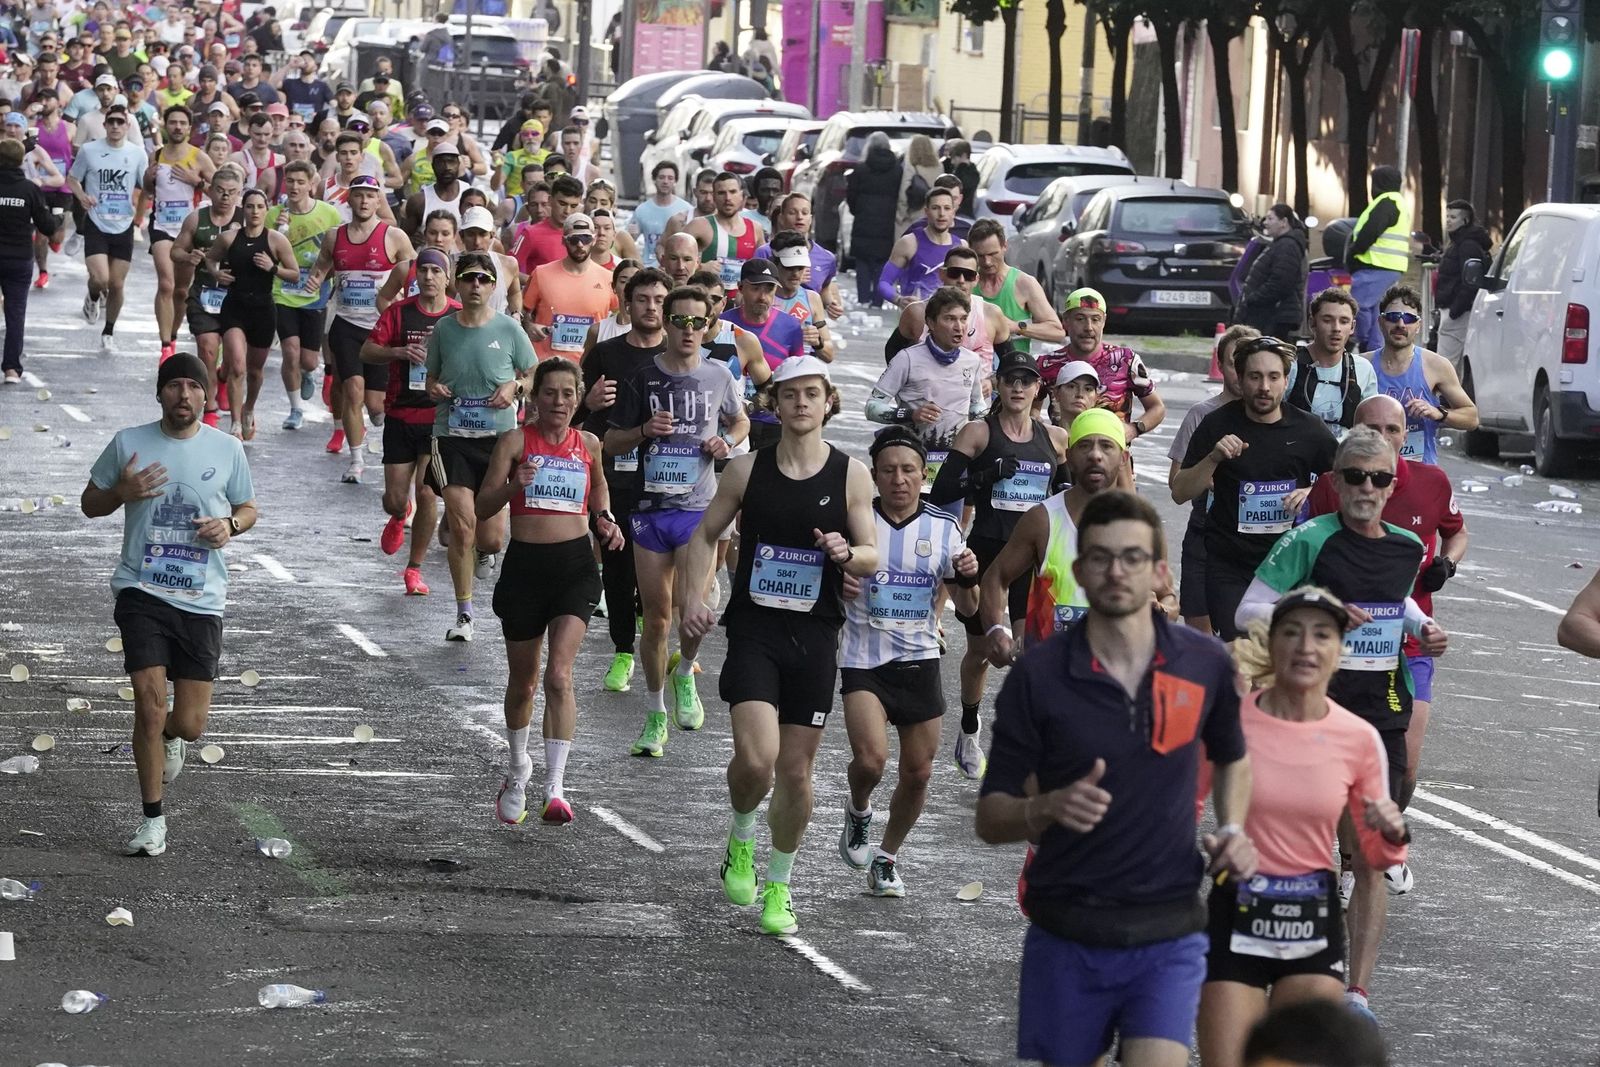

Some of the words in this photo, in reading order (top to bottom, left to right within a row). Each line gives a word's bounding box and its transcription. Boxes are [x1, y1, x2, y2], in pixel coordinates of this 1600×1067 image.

[97, 168, 121, 185] 10K
[1159, 292, 1185, 301] 4249
[561, 334, 583, 343] QUIZZ
[648, 389, 714, 422] BLUE
[458, 418, 487, 429] JORGE
[671, 423, 697, 434] ribe
[662, 446, 693, 455] ZURICH
[547, 459, 580, 470] ZURICH
[662, 461, 679, 469] 7477
[547, 474, 566, 483] 6203
[652, 470, 688, 483] JAUME
[1013, 478, 1029, 486] 6290
[534, 484, 577, 500] MAGALI
[1259, 483, 1290, 492] ZURICH
[992, 490, 1008, 499] BIBI
[1260, 500, 1277, 508] 5803
[777, 550, 817, 563] ZURICH
[165, 563, 184, 574] 8248
[776, 568, 798, 579] 5847
[152, 572, 193, 588] NACHO
[893, 574, 928, 584] ZURICH
[758, 578, 813, 597] CHARLIE
[892, 592, 912, 601] 6632
[870, 606, 890, 617] JOSE
[891, 608, 929, 618] MARTINEZ
[1361, 627, 1382, 636] 5894
[1251, 918, 1315, 940] OLVIDO
